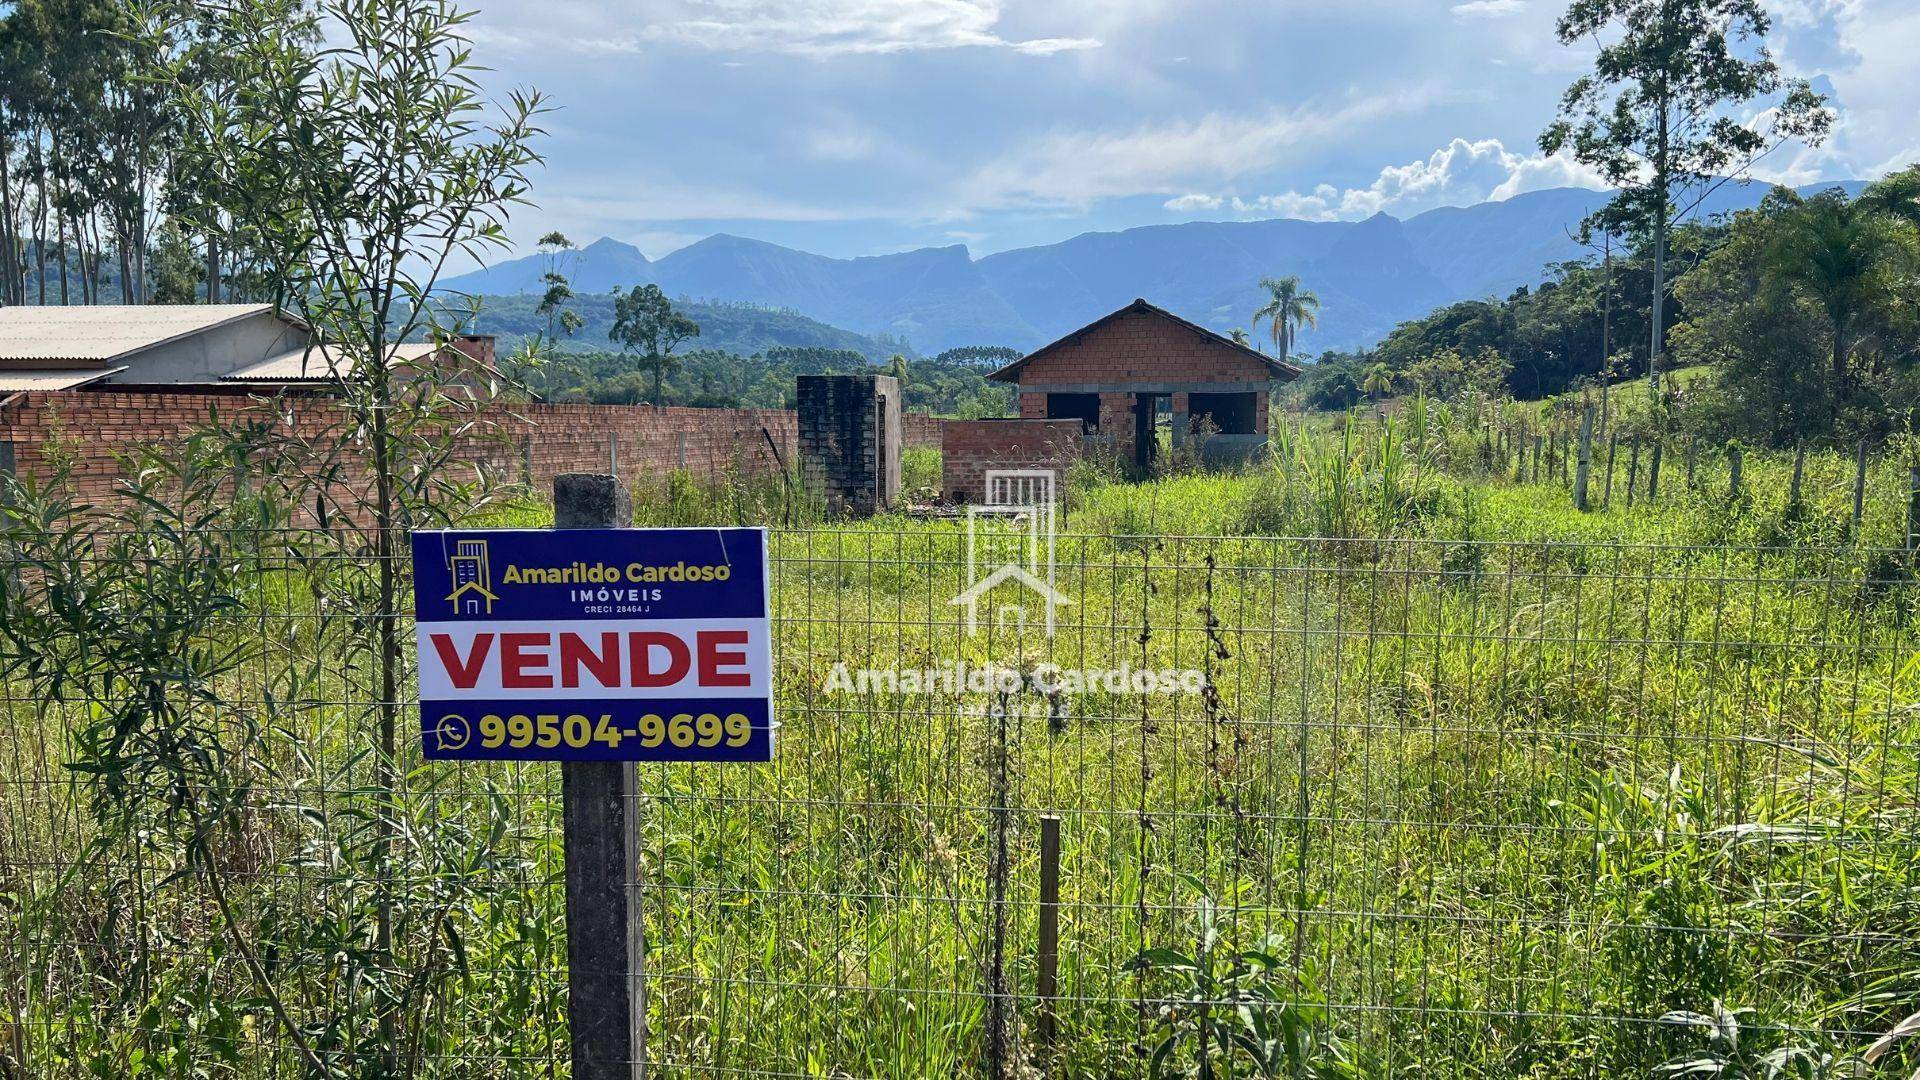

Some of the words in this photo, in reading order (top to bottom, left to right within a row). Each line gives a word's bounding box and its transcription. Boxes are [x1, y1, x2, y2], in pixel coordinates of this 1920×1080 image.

[503, 562, 620, 584] Amarildo
[626, 561, 731, 583] Cardoso
[571, 586, 662, 602] IMÓVEIS
[584, 605, 612, 613] CRECI
[645, 605, 650, 613] J
[429, 630, 751, 689] VENDE
[479, 713, 752, 748] 99504-9699
